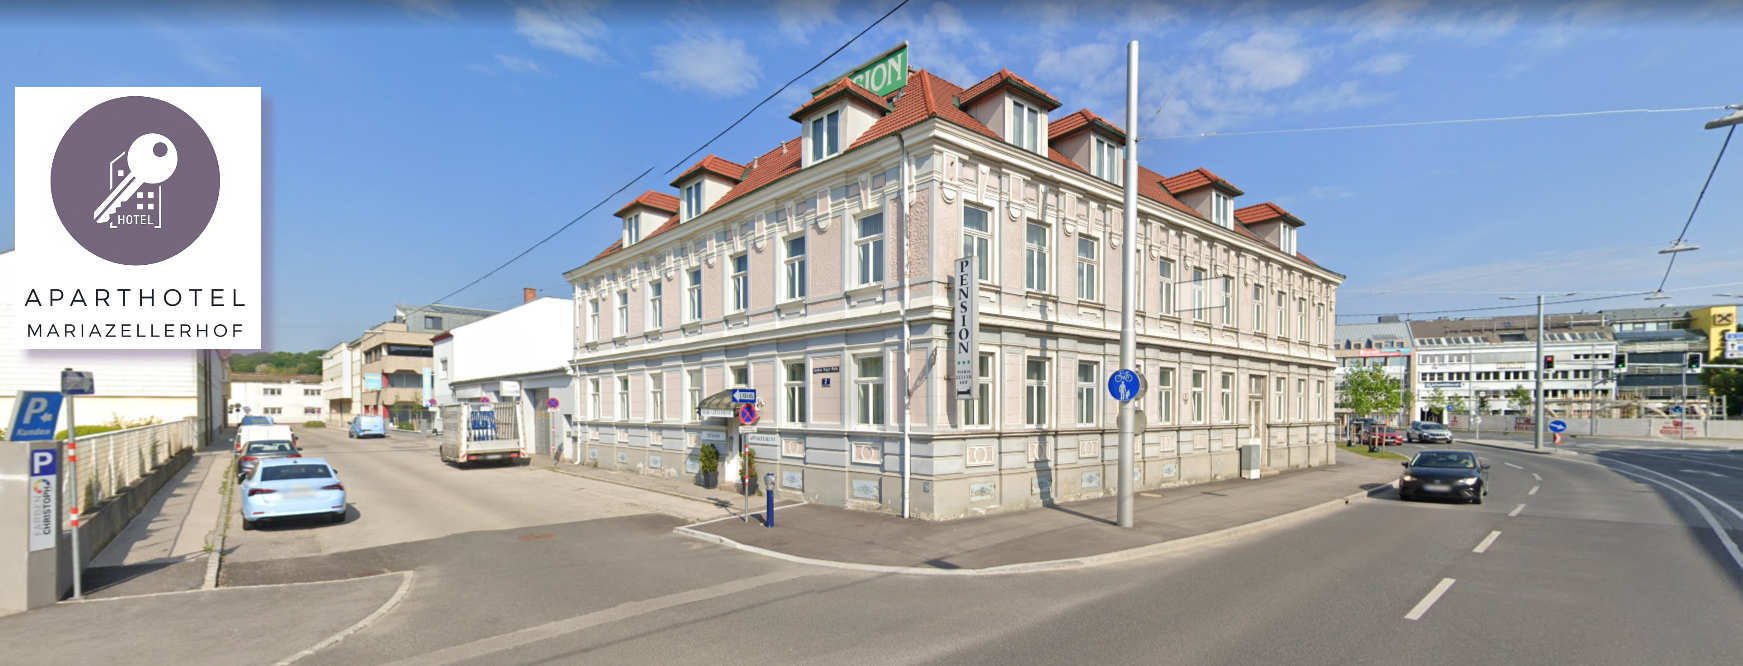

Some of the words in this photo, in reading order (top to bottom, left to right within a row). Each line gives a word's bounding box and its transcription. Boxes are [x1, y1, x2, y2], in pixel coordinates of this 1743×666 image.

[852, 52, 903, 92] SION
[958, 259, 970, 354] PENSION
[22, 397, 48, 424] P
[16, 428, 51, 437] Kunden
[33, 451, 53, 475] P
[33, 495, 42, 536] FARBEN
[42, 485, 52, 536] CHRISTOPH
